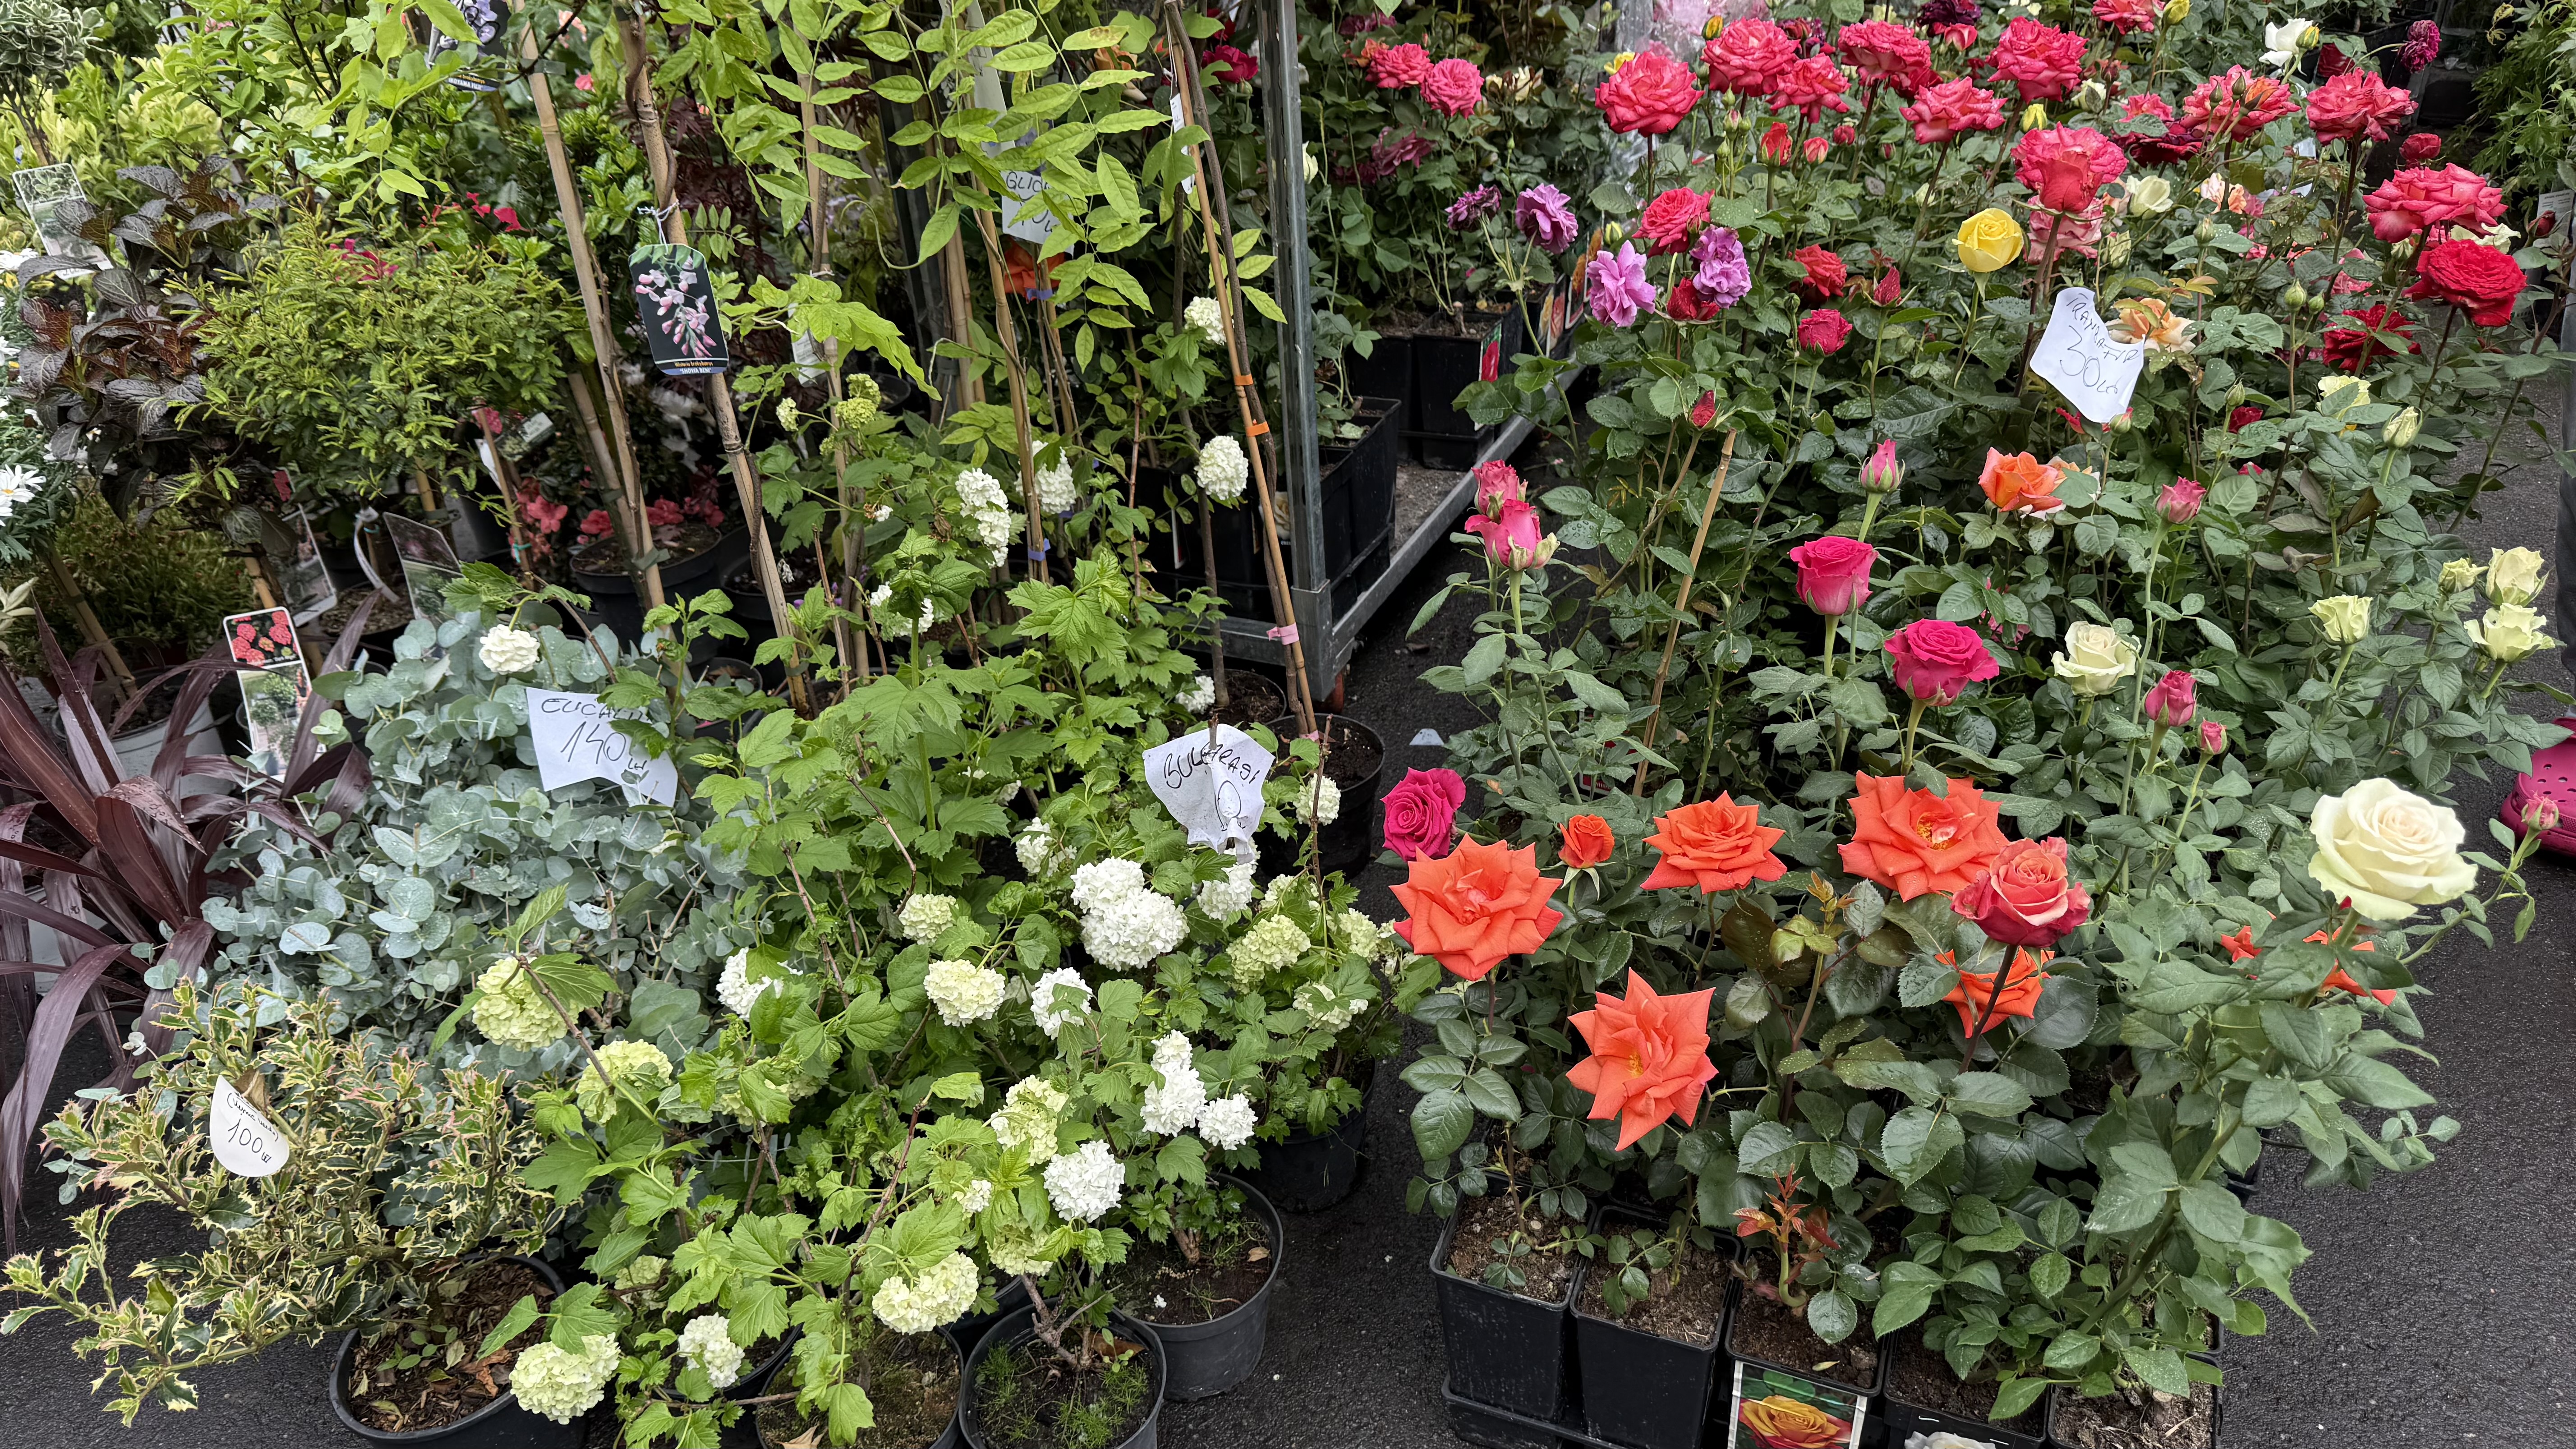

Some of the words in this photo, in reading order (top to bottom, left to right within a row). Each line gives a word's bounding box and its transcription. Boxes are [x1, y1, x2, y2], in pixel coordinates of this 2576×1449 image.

[2059, 325, 2101, 387] 30
[560, 721, 626, 765] 140
[227, 1118, 263, 1153] 100
